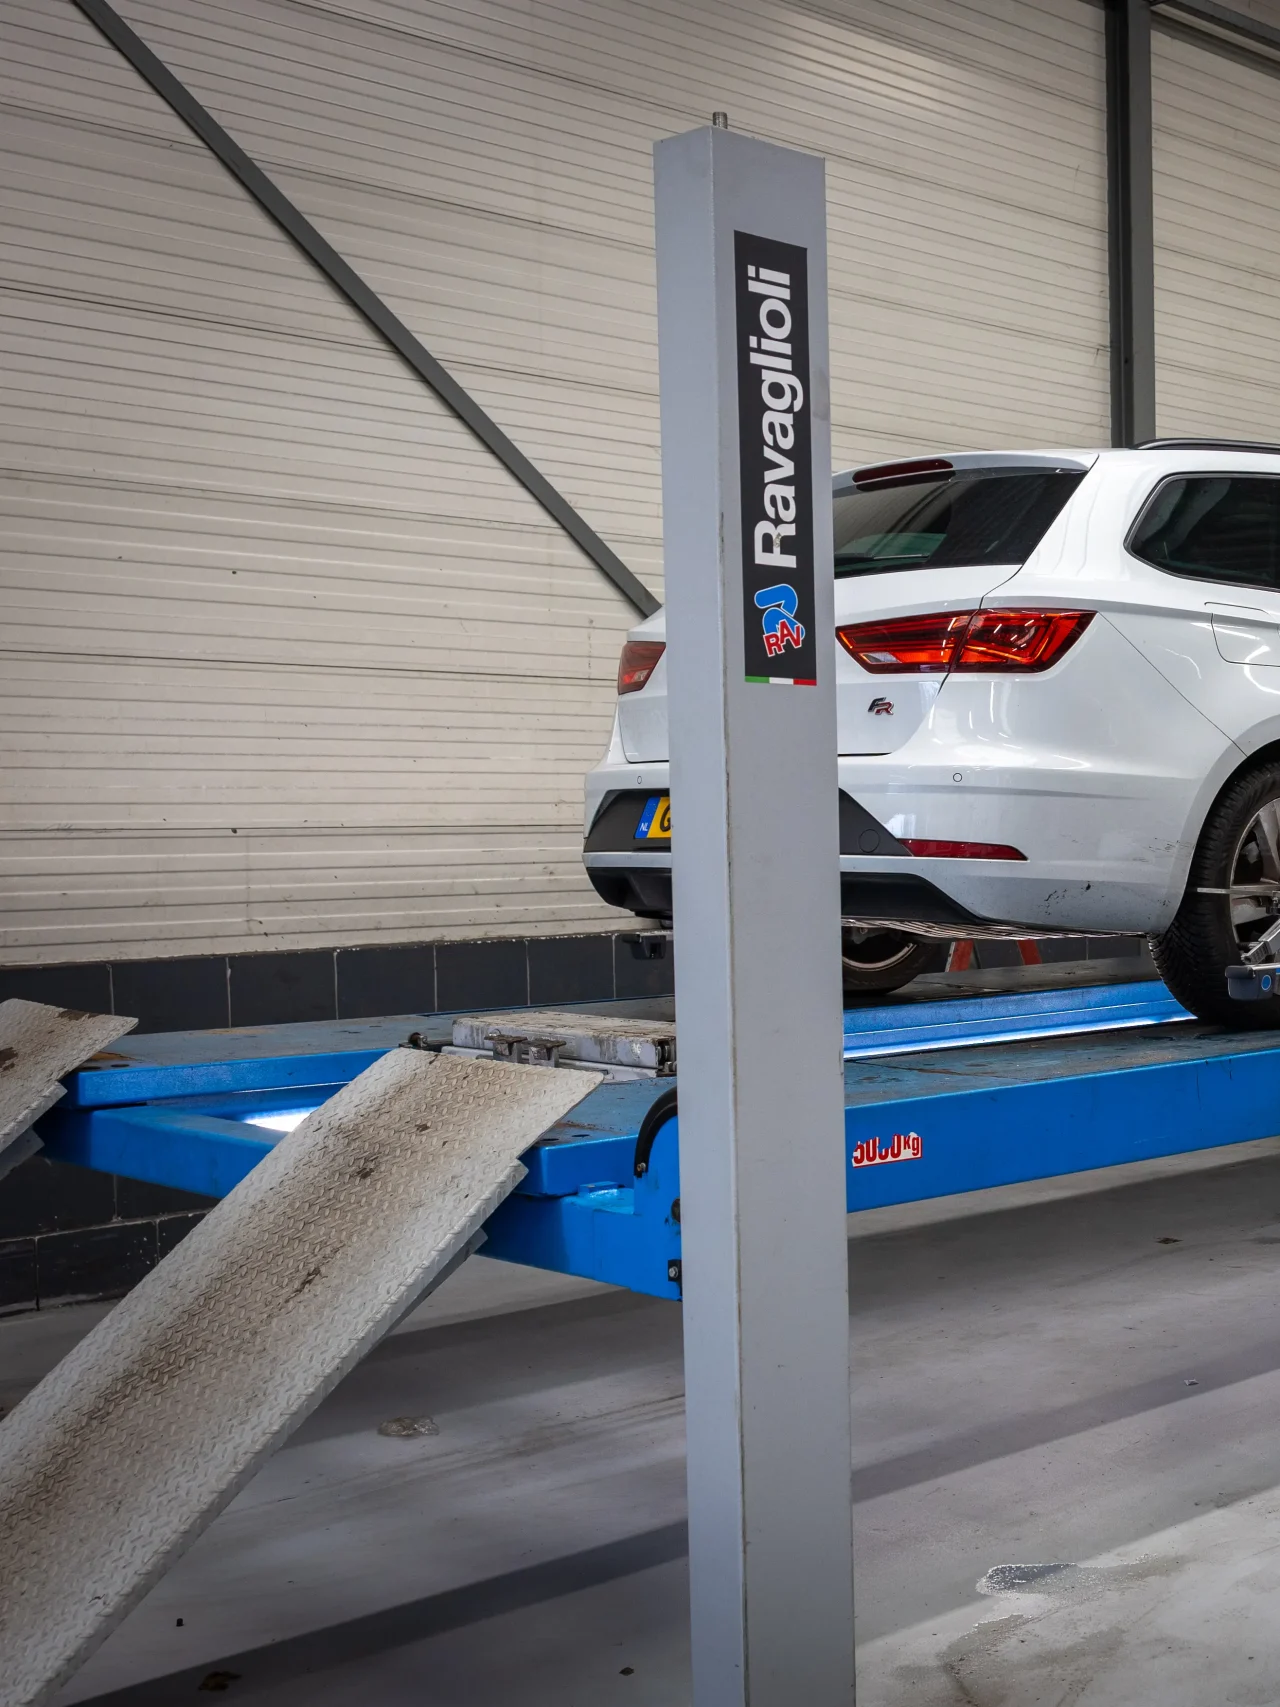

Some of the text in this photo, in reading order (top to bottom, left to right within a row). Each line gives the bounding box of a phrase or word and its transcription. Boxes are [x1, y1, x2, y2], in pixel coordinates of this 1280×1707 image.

[747, 264, 804, 568] Ravaglioli
[763, 619, 803, 657] RAV
[868, 697, 894, 715] FR
[640, 822, 649, 831] NL
